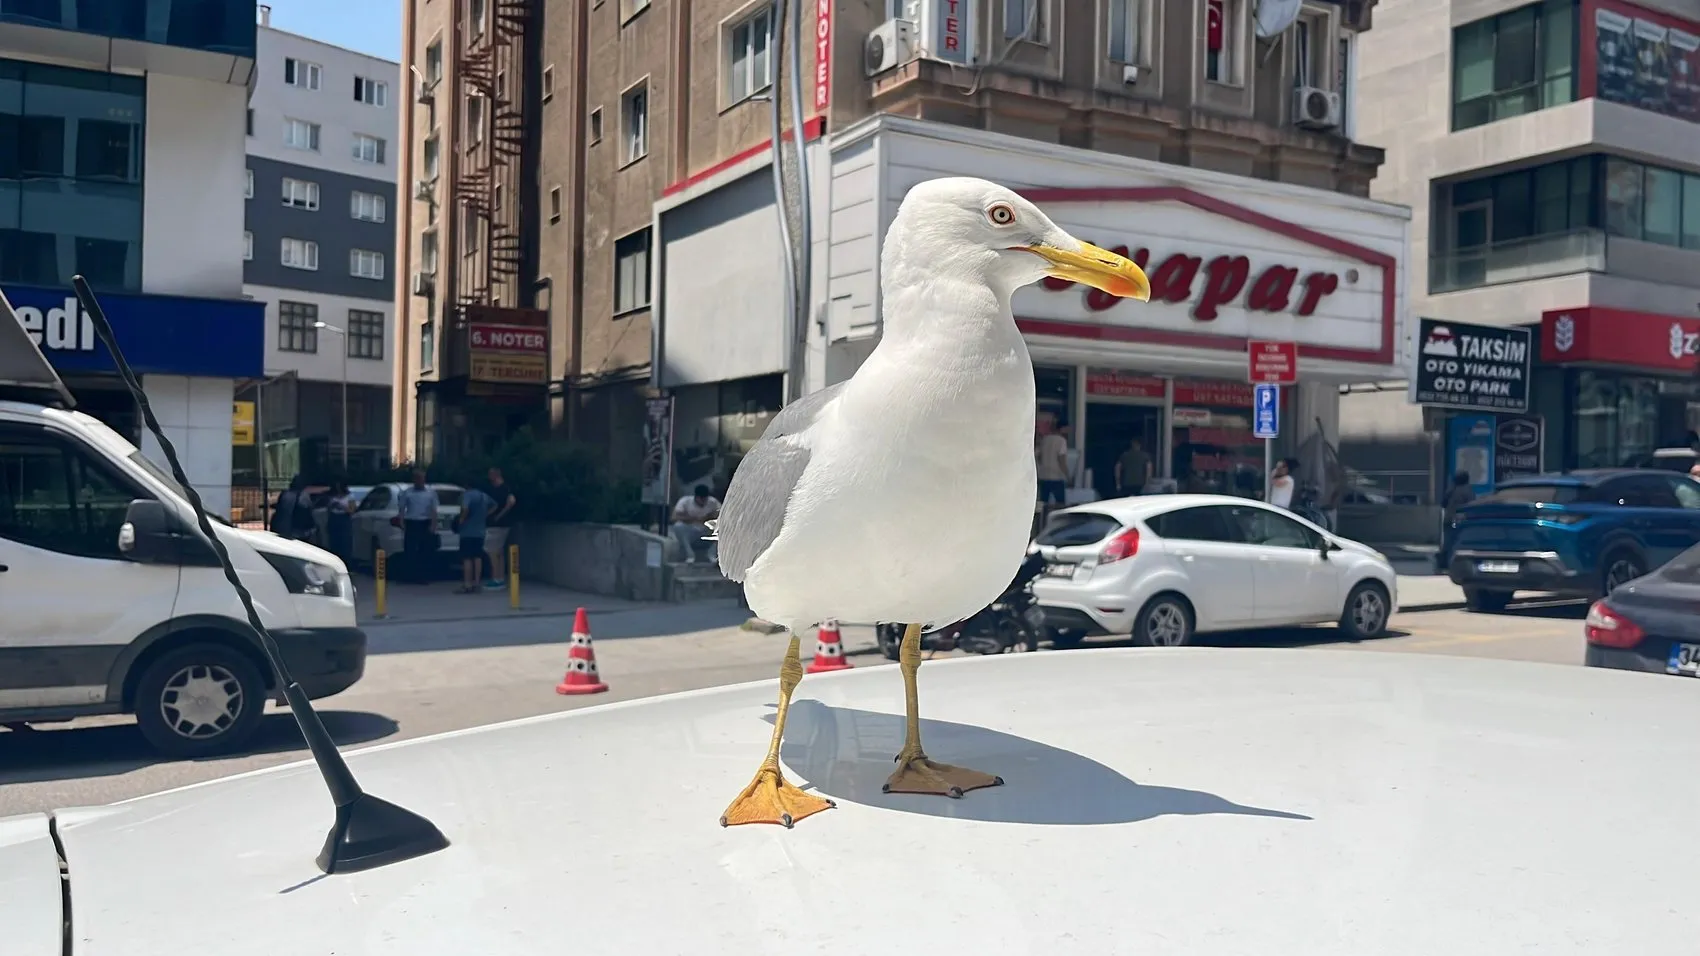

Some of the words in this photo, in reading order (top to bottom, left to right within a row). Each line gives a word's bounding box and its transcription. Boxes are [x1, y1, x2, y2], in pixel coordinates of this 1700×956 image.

[817, 0, 829, 106] NOTER
[1043, 240, 1338, 321] yapar
[491, 332, 545, 348] NOTER
[1460, 333, 1526, 363] TAKSİM
[1425, 359, 1459, 375] OTO
[1463, 362, 1522, 380] YIKAMA
[1433, 376, 1467, 393] OTO
[1469, 380, 1512, 397] PARK
[1261, 389, 1272, 409] P
